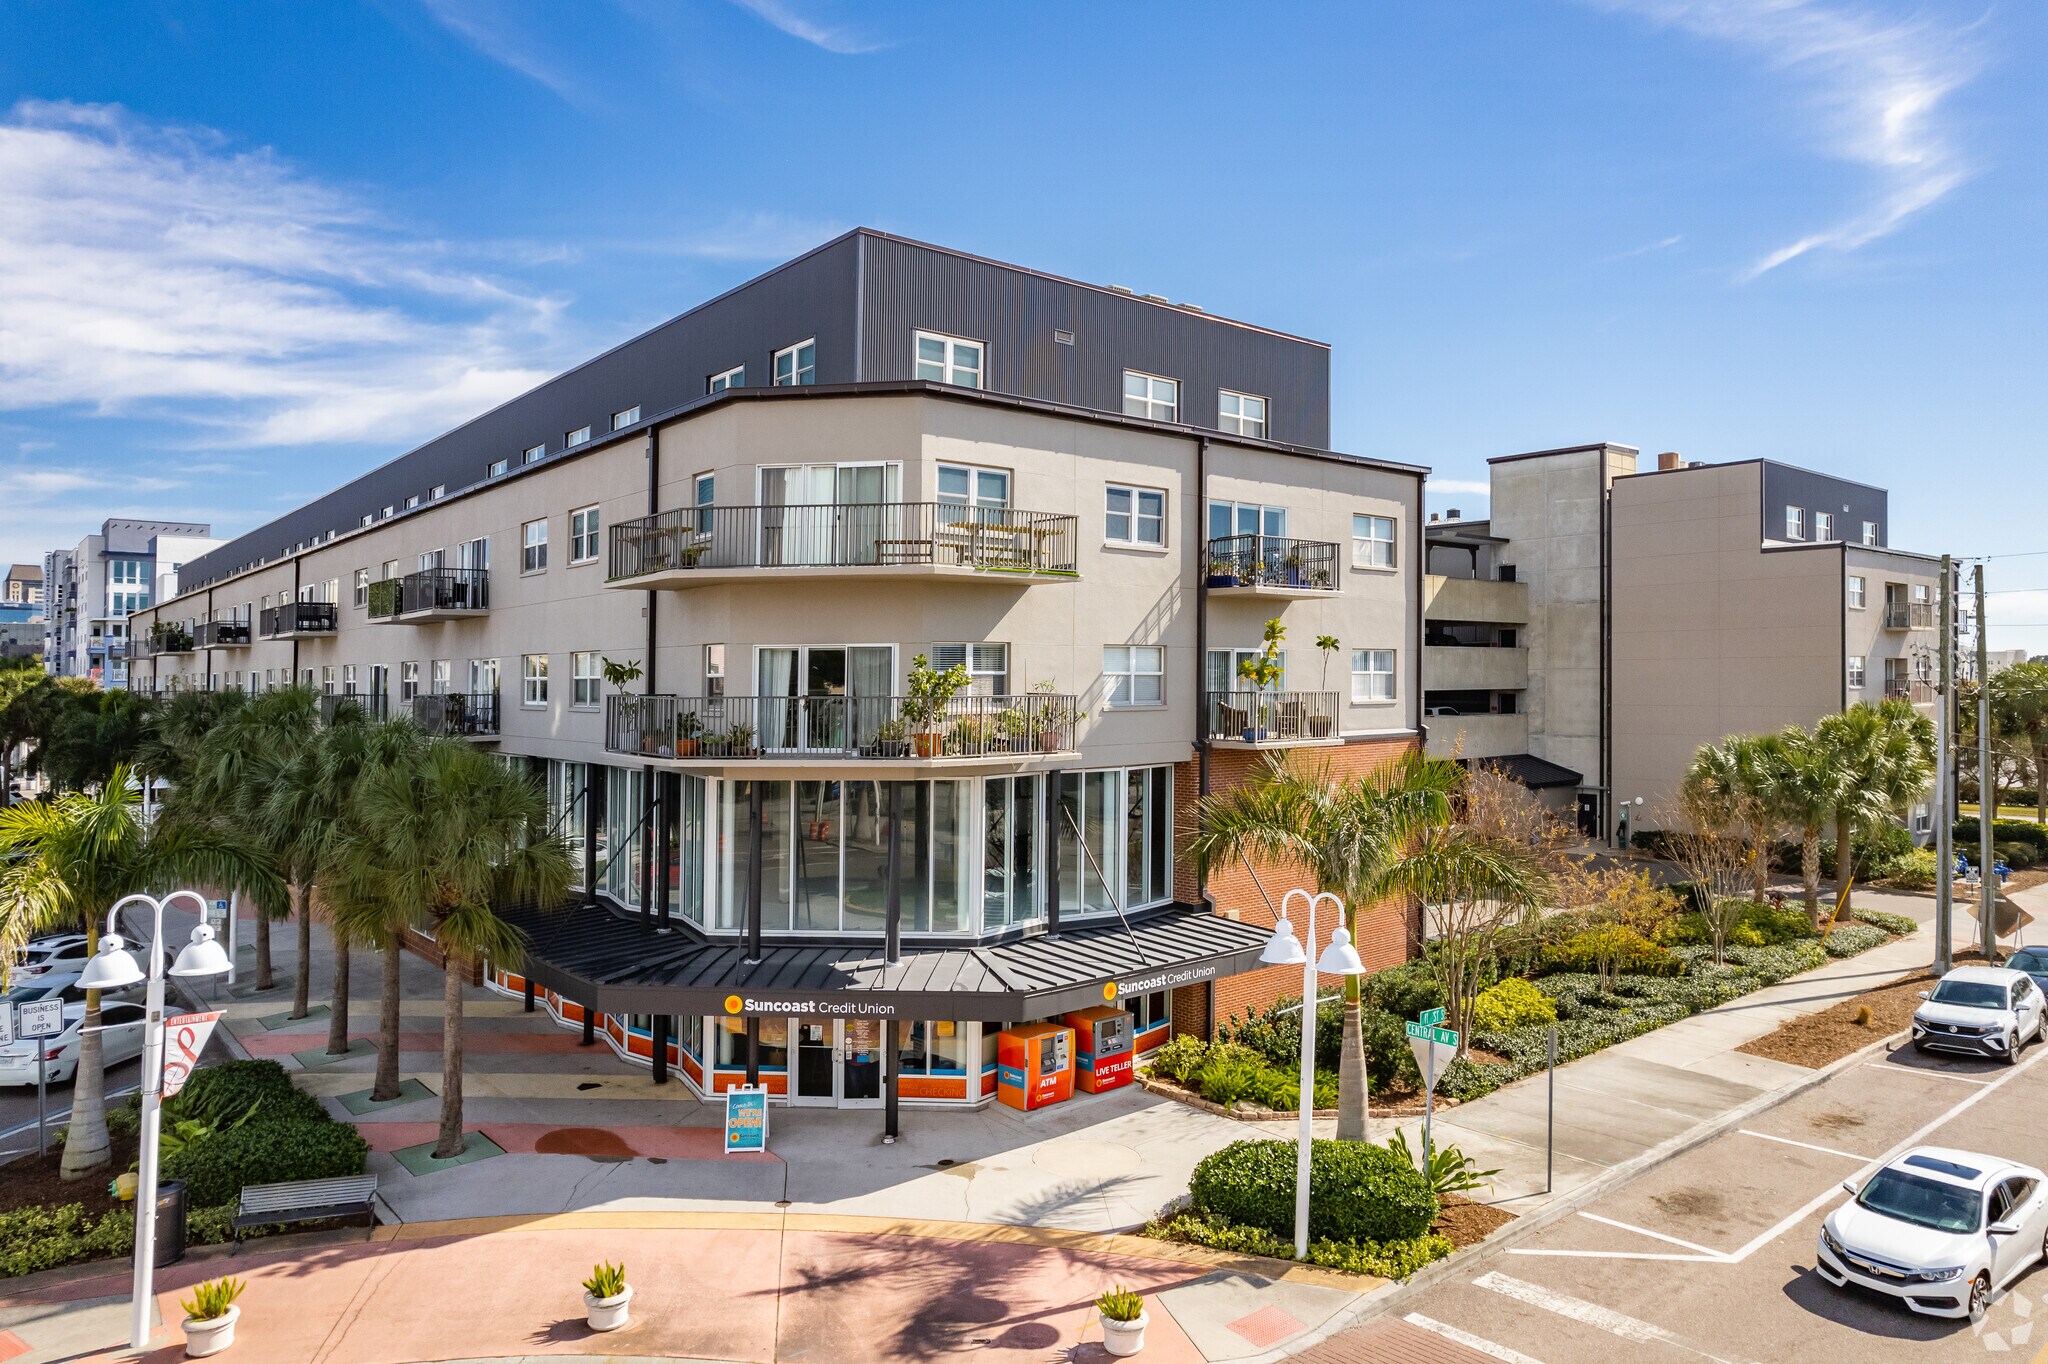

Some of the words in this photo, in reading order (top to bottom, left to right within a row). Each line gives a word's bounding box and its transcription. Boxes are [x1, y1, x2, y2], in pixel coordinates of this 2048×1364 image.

[1118, 974, 1167, 995] Suncoast
[1167, 973, 1192, 985] Credit
[1192, 966, 1216, 979] Union
[23, 1003, 59, 1015] BUSINESS
[744, 999, 816, 1013] Suncoast
[818, 1002, 857, 1014] Credit
[858, 1003, 895, 1014] Union
[37, 1014, 45, 1022] IS
[1433, 1010, 1439, 1022] ST
[31, 1022, 51, 1032] OPEN
[1407, 1023, 1436, 1041] CENTRAL
[1095, 1066, 1110, 1077] LIVE
[1110, 1060, 1132, 1074] TELLER
[1040, 1076, 1057, 1088] ATM
[918, 1087, 966, 1097] CHECKING
